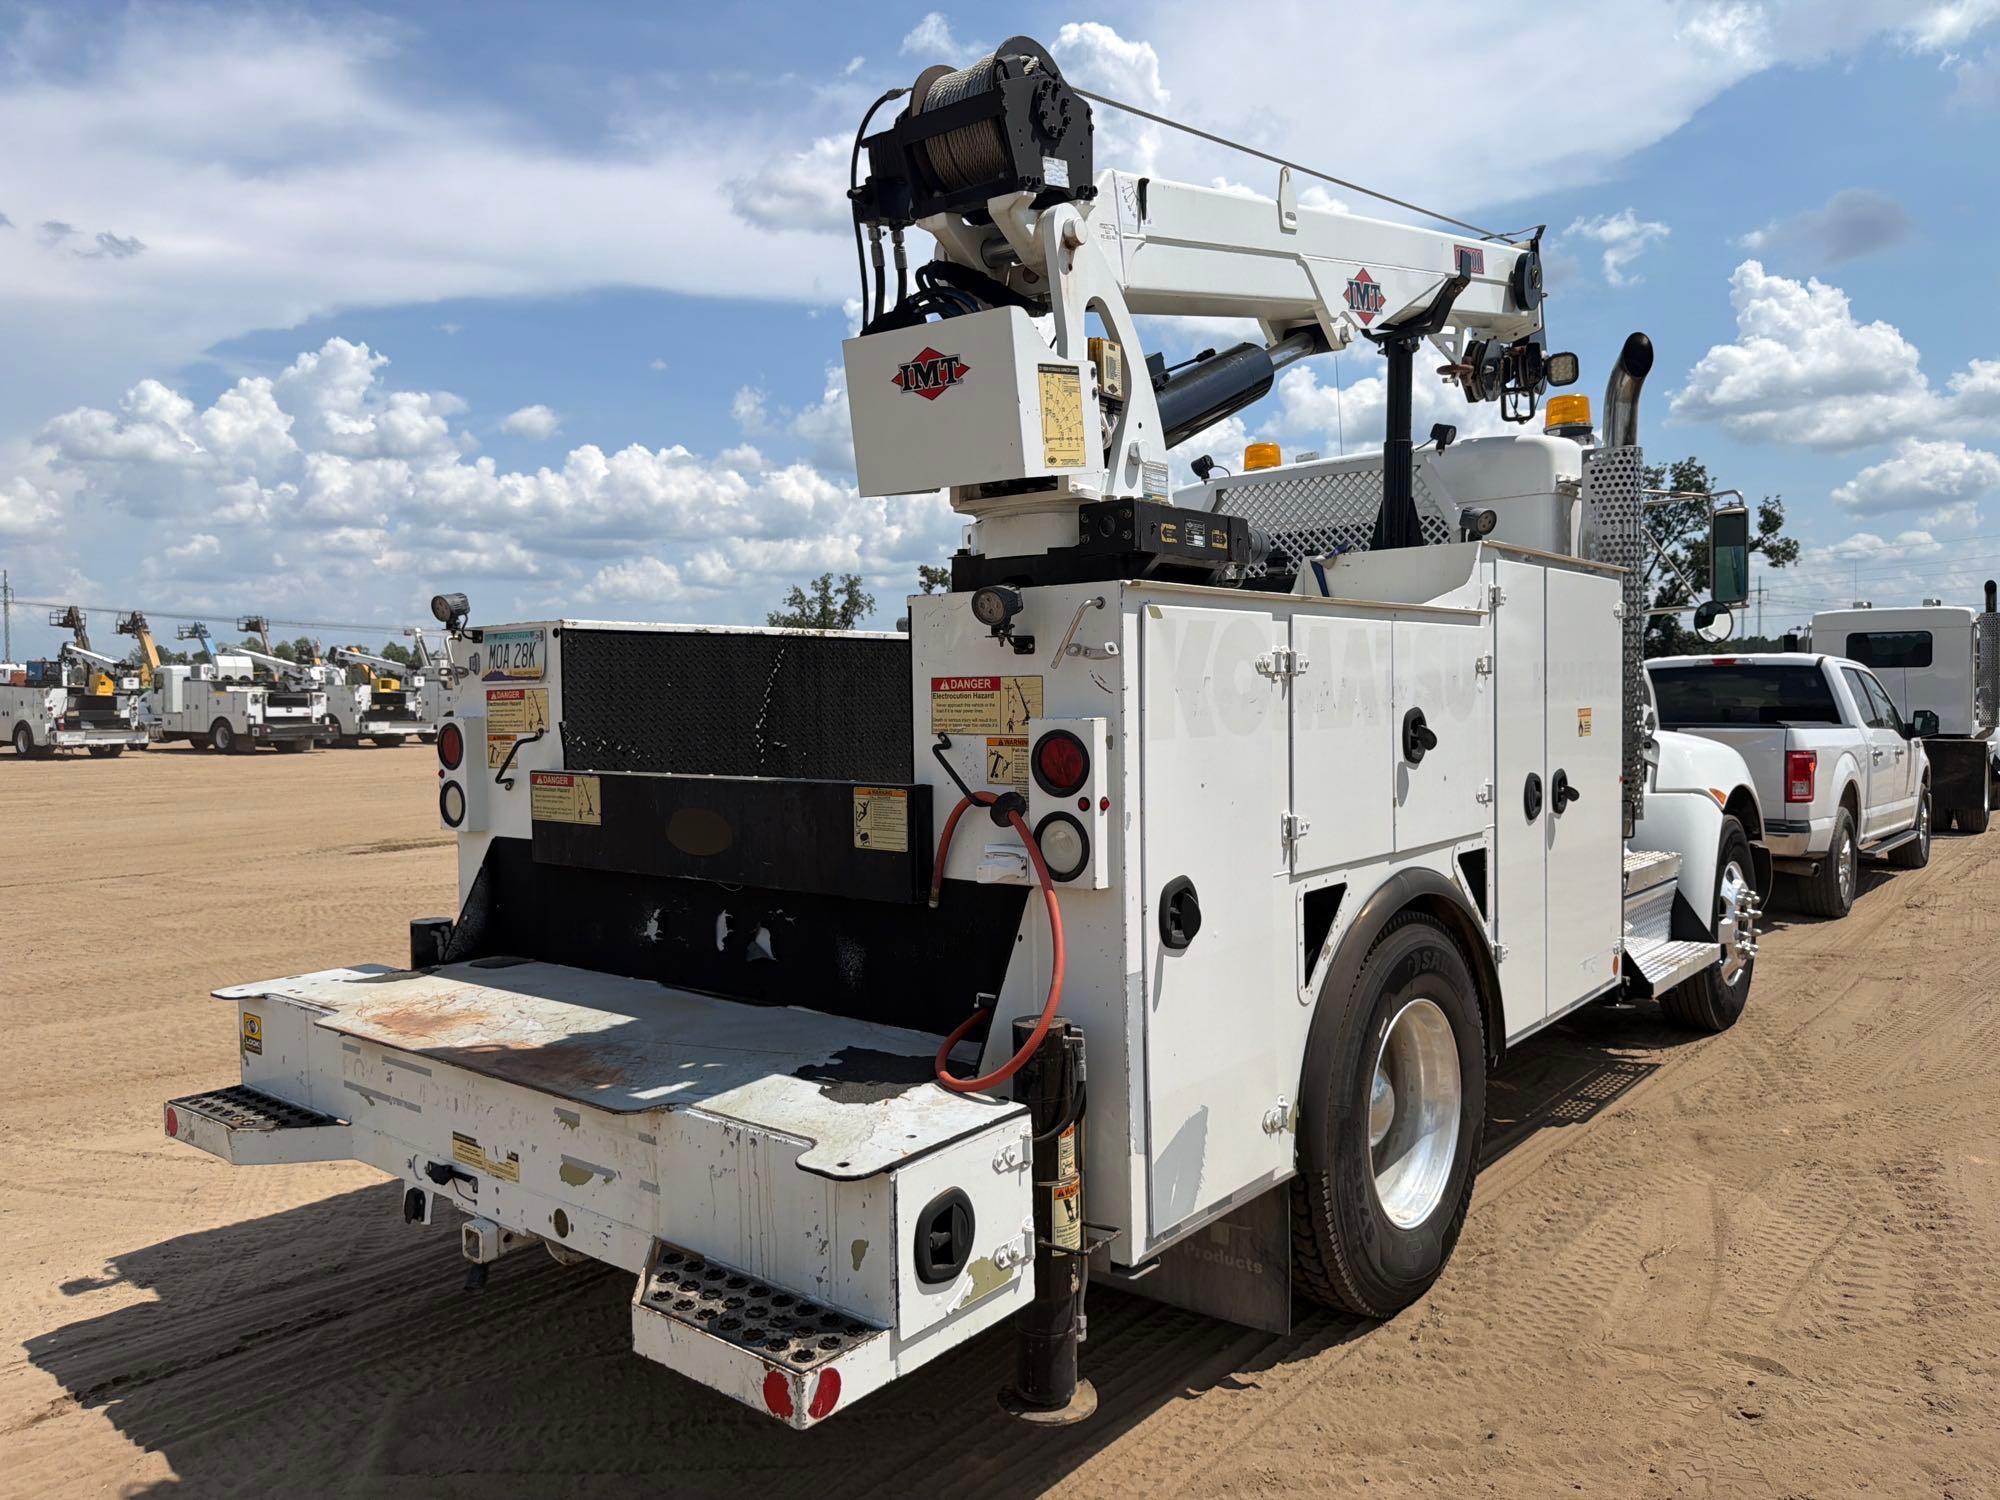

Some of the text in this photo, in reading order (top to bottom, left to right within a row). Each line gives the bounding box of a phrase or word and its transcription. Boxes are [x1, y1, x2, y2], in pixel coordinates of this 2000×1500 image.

[1348, 279, 1382, 314] IMT
[899, 354, 961, 393] IMT
[488, 643, 510, 670] MOA
[513, 641, 537, 669] 28K
[950, 679, 991, 689] DANGER
[497, 691, 520, 699] DANGER
[932, 692, 971, 700] Electrocution
[542, 776, 568, 784] DANGER
[1184, 1241, 1263, 1274] Products
